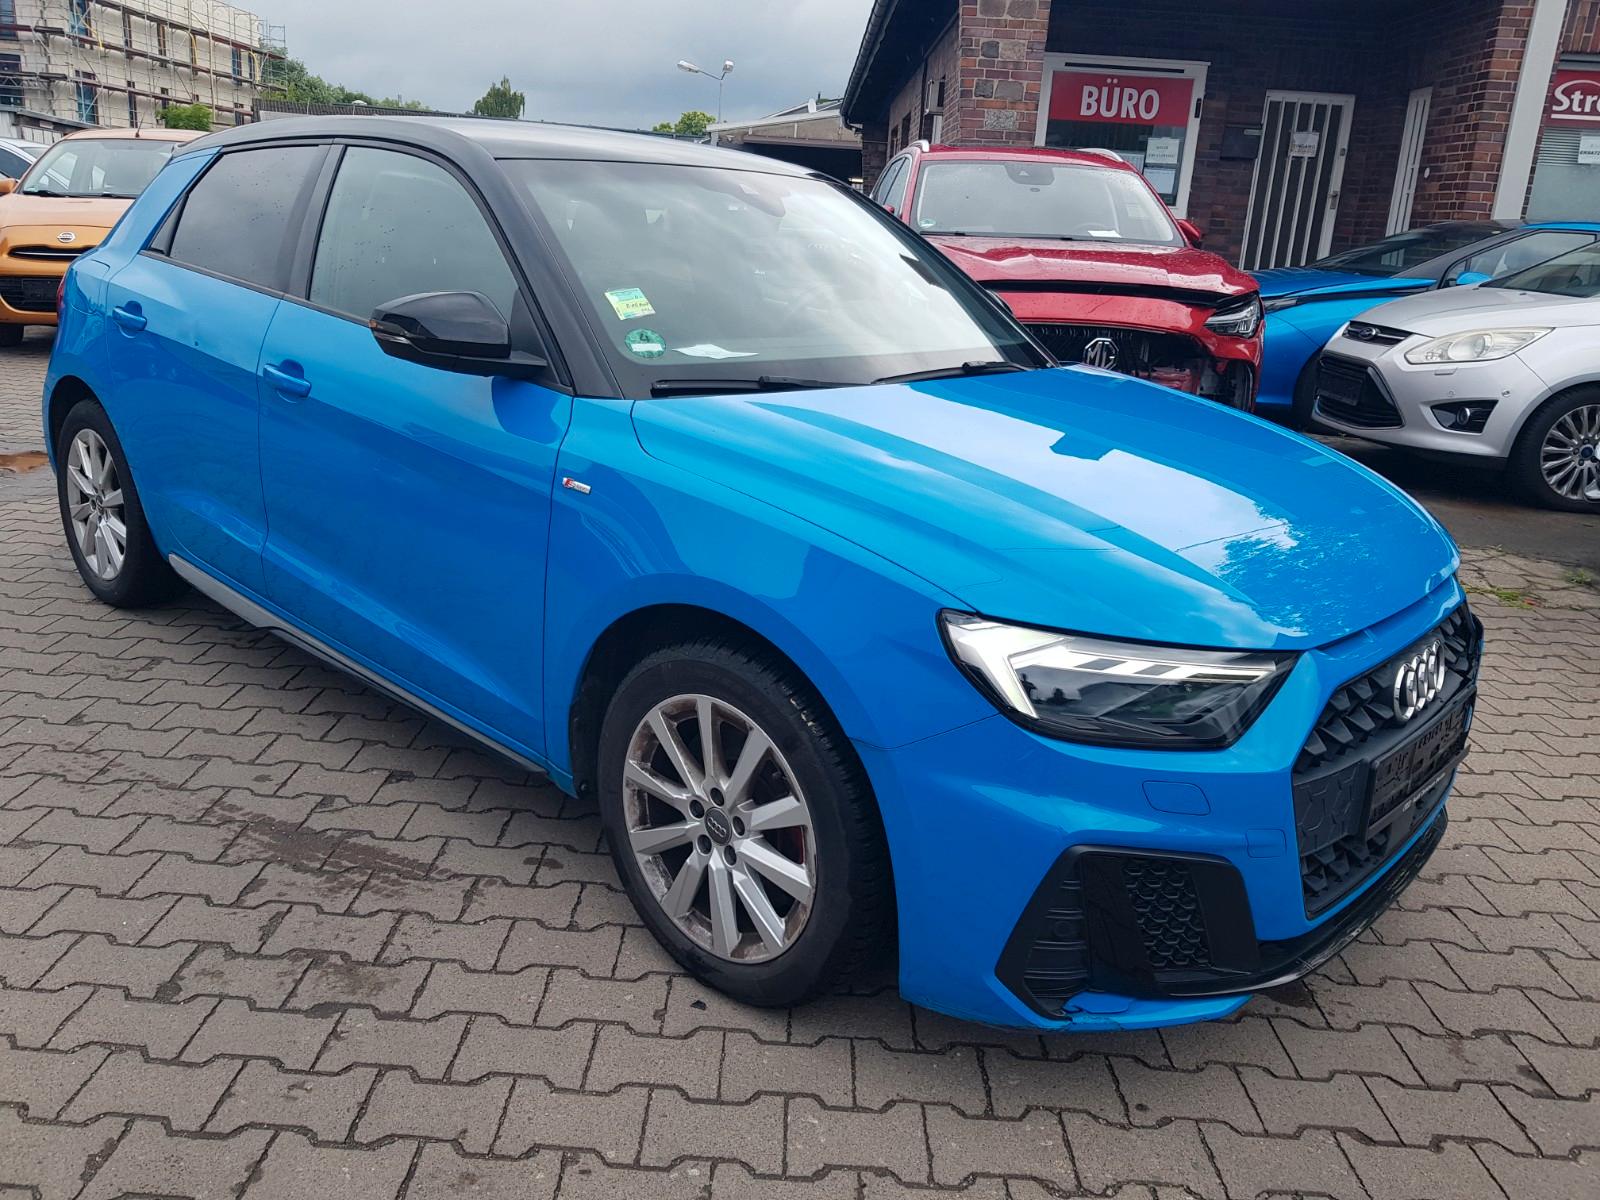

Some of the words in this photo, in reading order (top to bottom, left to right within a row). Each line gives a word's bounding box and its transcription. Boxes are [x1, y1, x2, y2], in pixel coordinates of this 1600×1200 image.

[1080, 78, 1160, 121] BÜRO
[1552, 80, 1600, 113] Str
[639, 333, 651, 343] 4
[1086, 341, 1117, 369] MG
